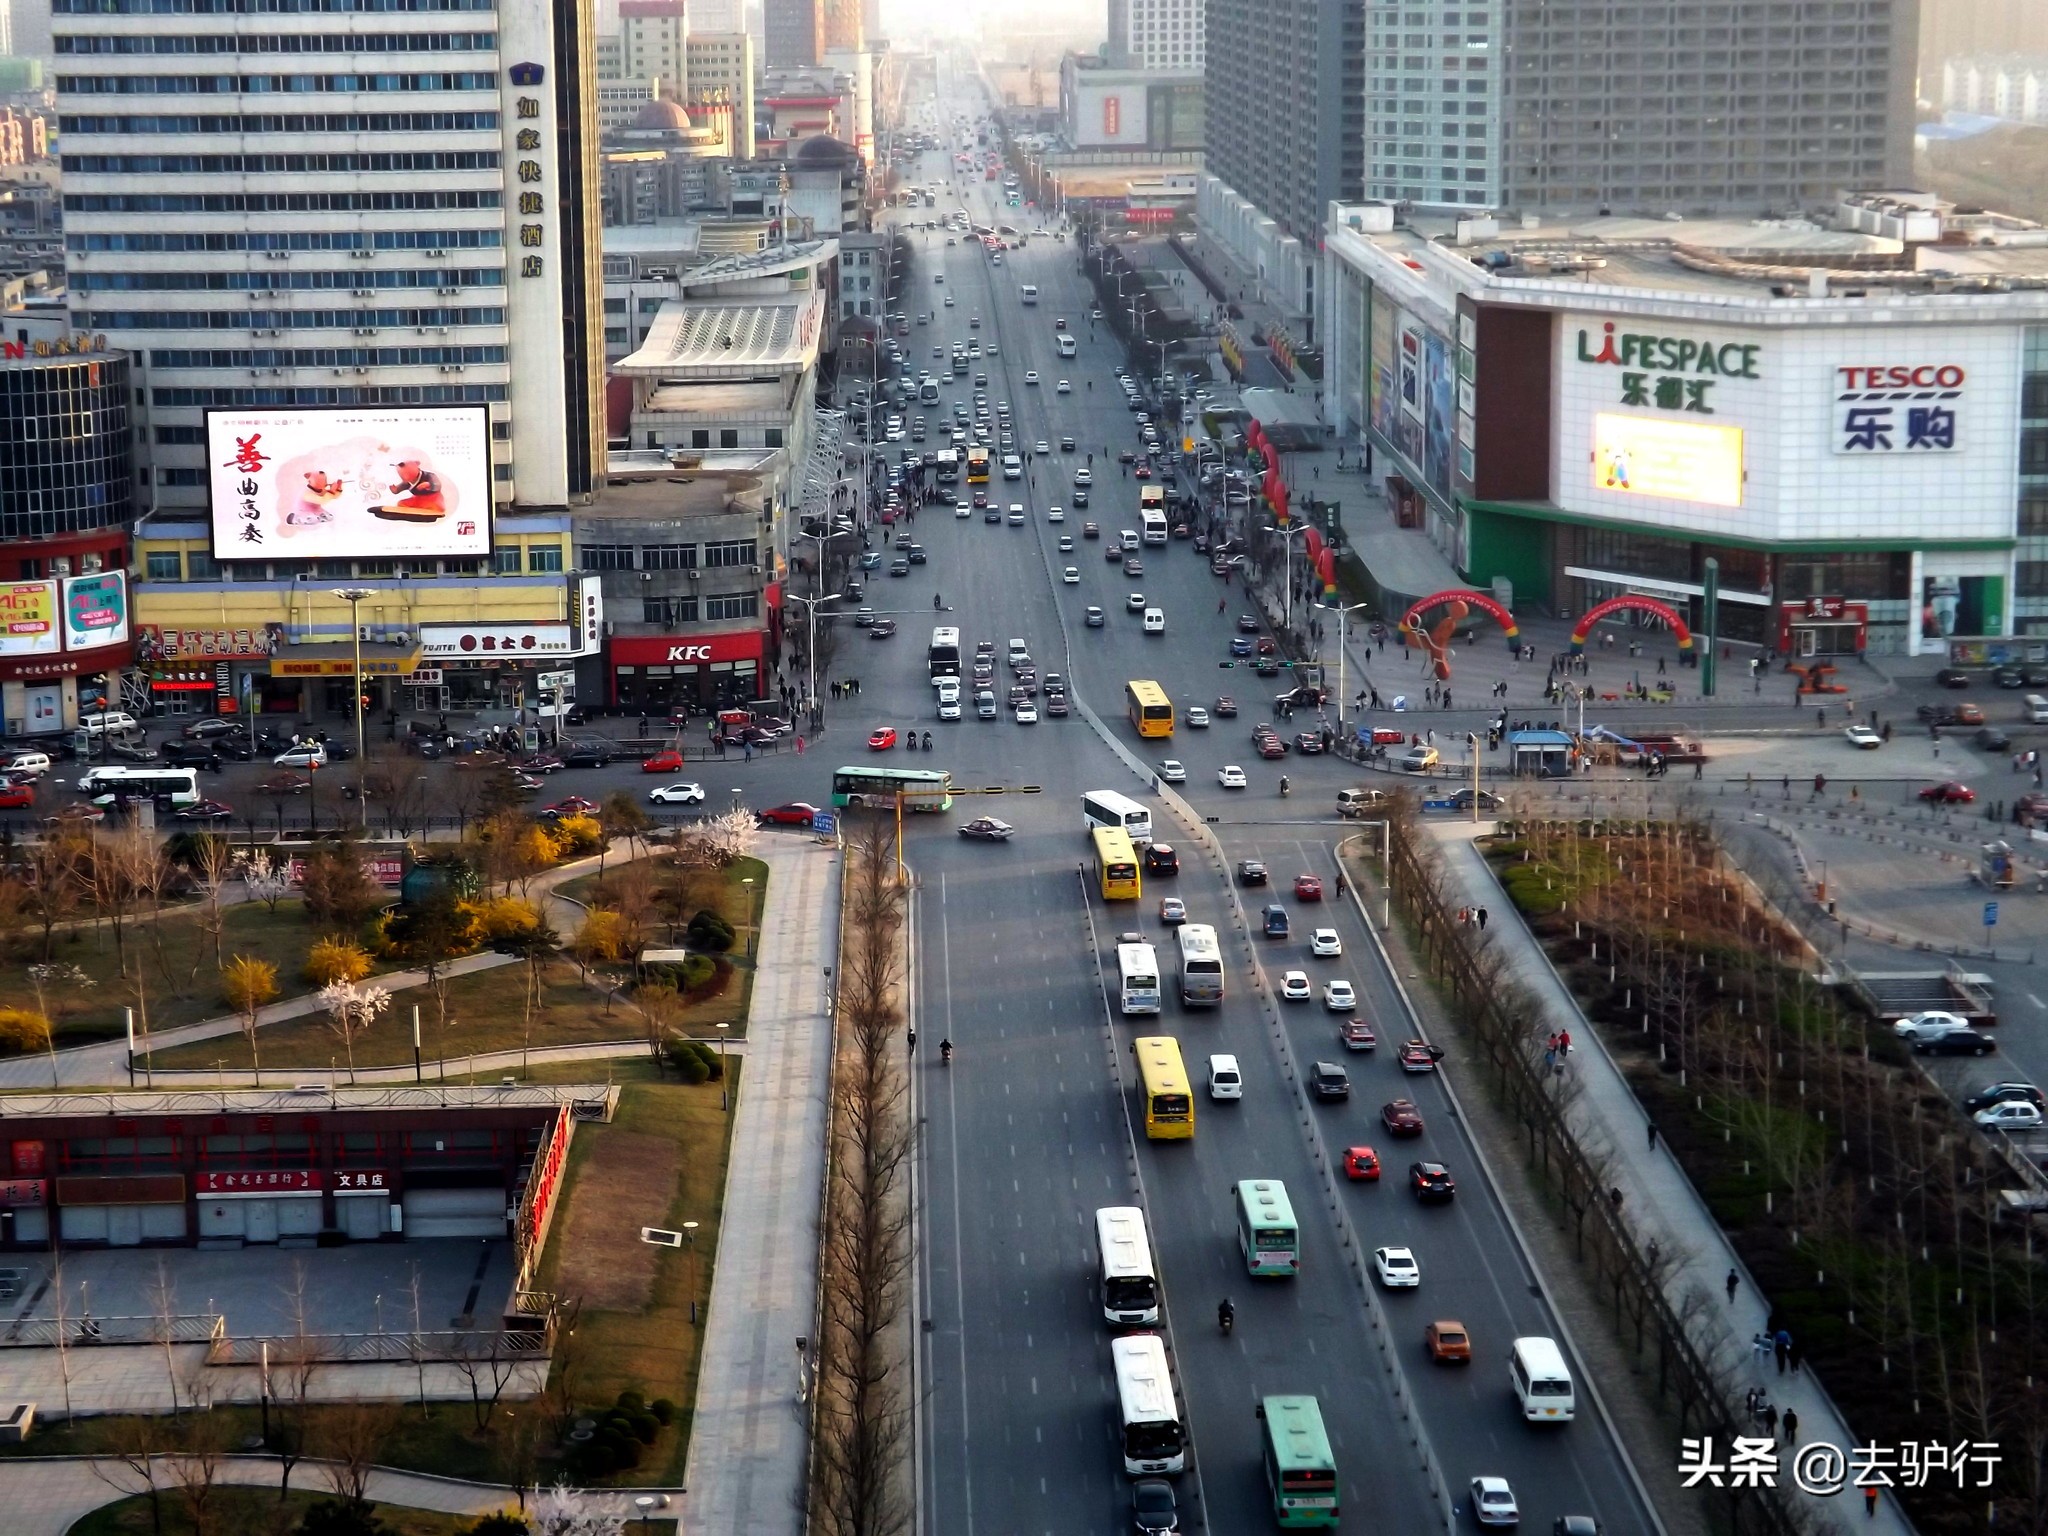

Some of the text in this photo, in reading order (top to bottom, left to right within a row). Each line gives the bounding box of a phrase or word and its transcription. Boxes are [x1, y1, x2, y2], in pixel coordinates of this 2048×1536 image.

[516, 97, 543, 279] 如家快捷酒店
[1838, 365, 1966, 389] TESCO
[1844, 406, 1957, 450] 乐购
[423, 644, 455, 652] FUJITEI
[667, 645, 711, 661] KFC
[339, 1174, 383, 1187] 文具店
